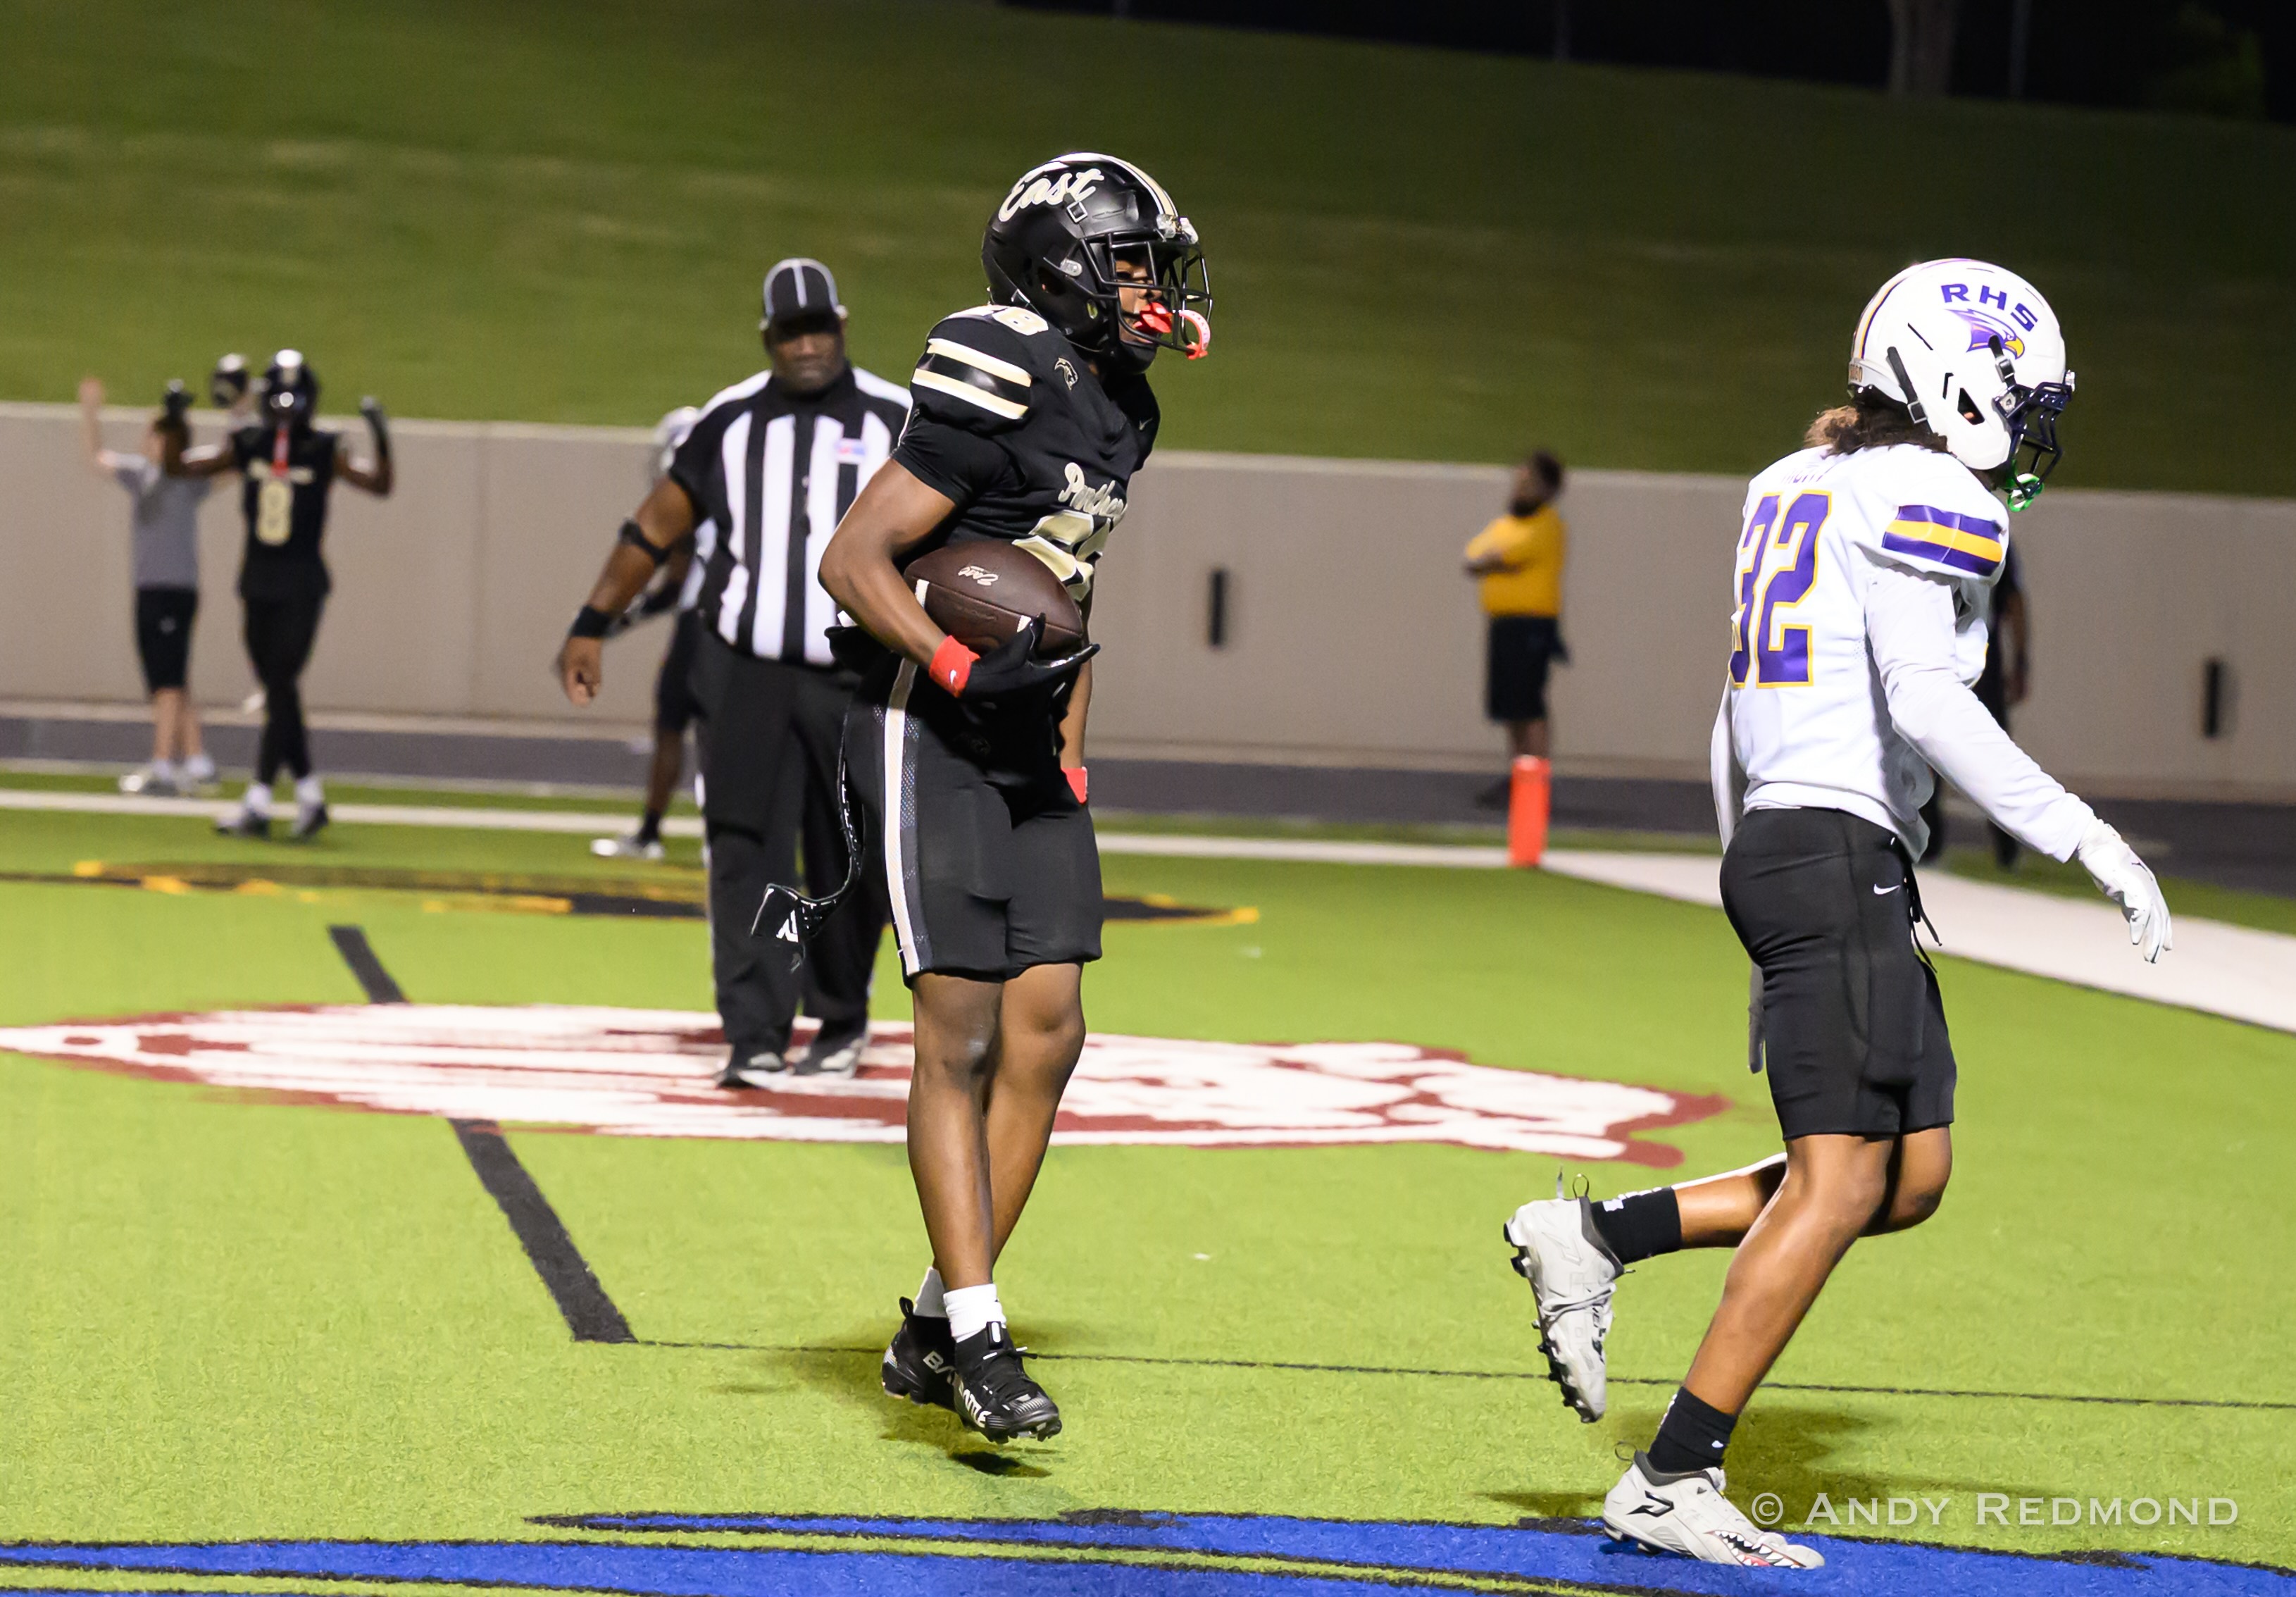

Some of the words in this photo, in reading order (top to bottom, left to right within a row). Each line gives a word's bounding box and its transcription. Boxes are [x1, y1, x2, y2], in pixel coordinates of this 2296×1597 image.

[998, 168, 1104, 222] East
[1940, 283, 2039, 333] RHS
[1728, 489, 1832, 690] 32
